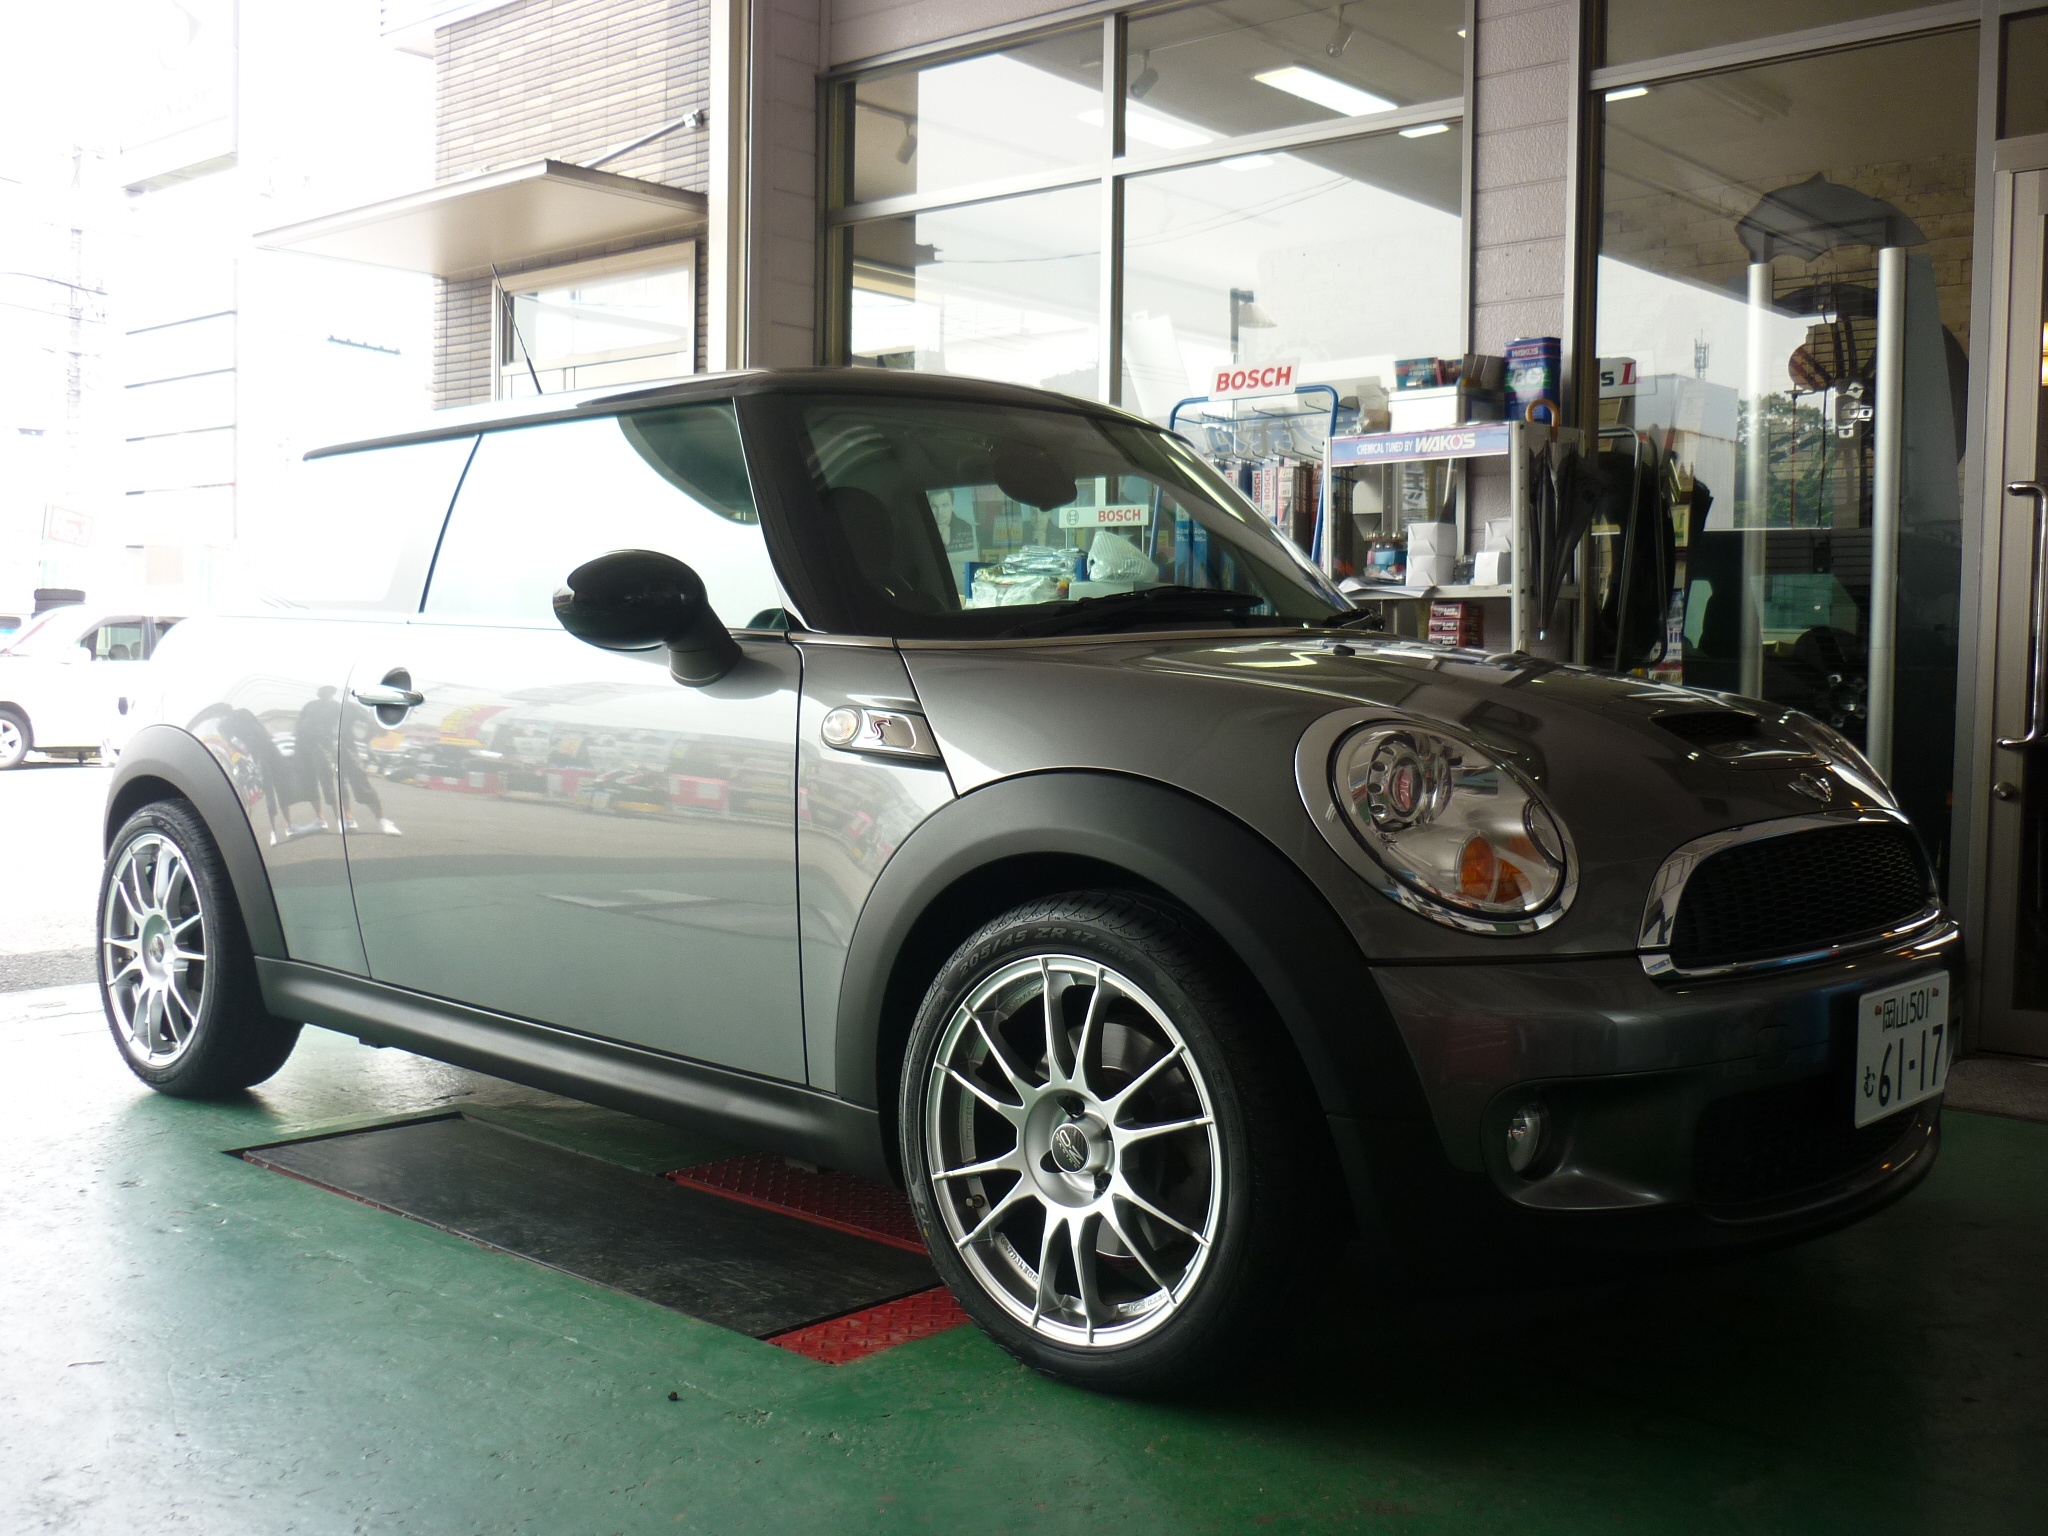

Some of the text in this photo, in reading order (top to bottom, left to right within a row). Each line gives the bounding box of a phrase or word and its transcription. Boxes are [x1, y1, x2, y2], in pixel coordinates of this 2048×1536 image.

[1215, 365, 1292, 393] BOSCH
[1356, 432, 1476, 455] CHEMICAL TUNED BY WAKO'S
[1097, 508, 1141, 523] BOSCH
[1033, 926, 1067, 939] ZR
[1072, 930, 1097, 942] 17
